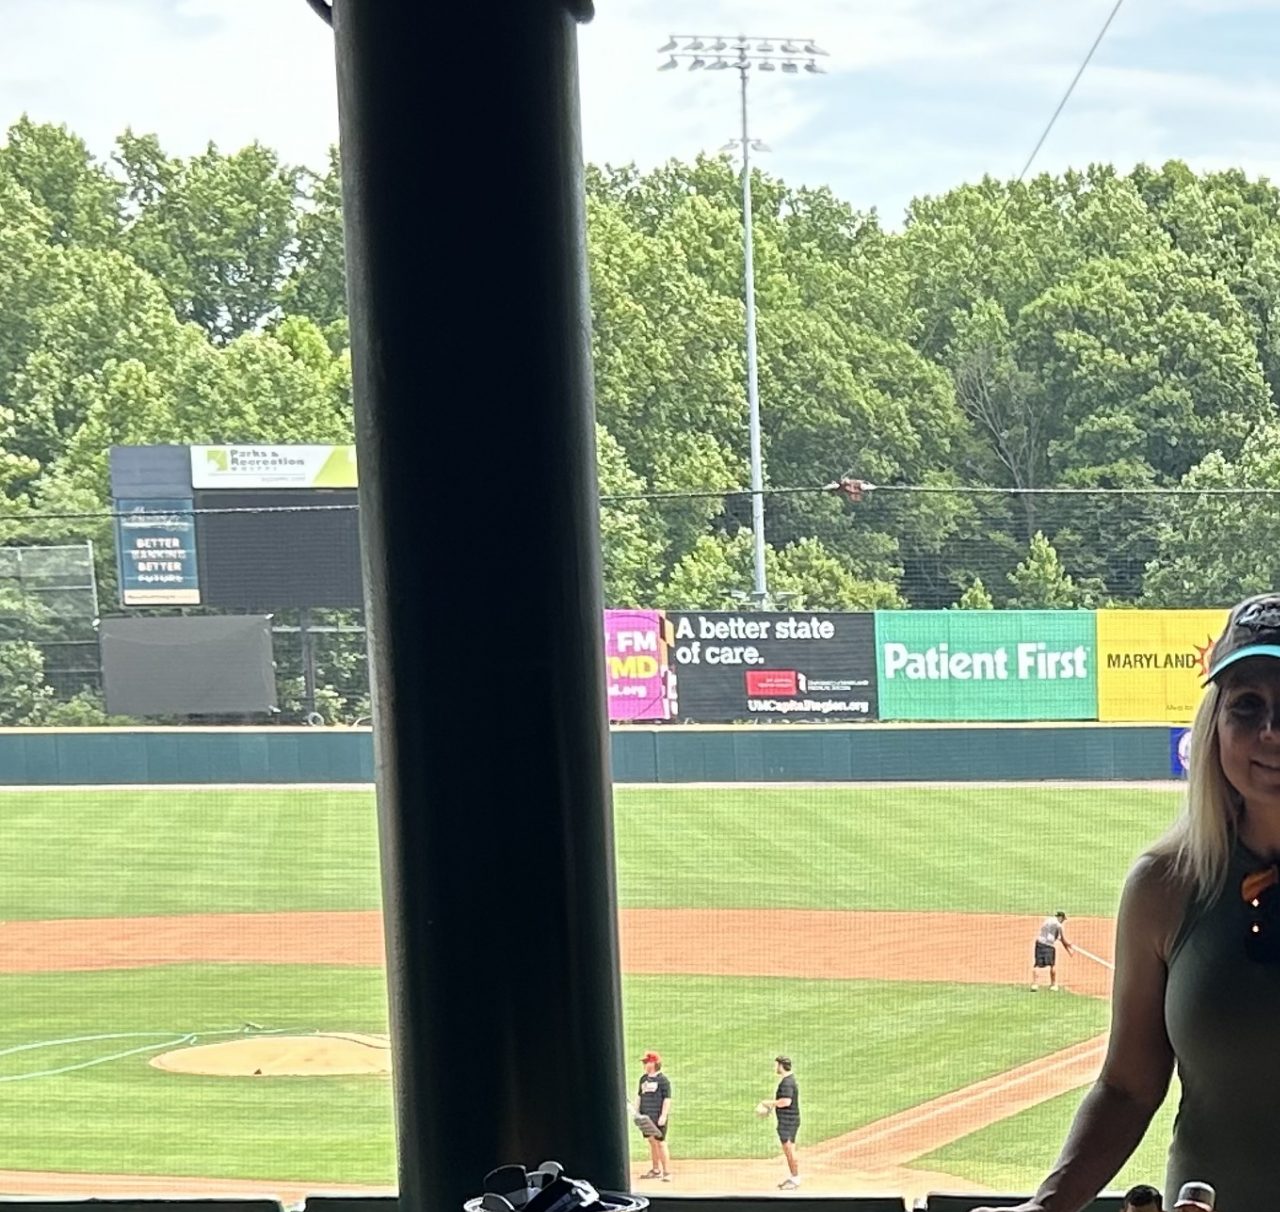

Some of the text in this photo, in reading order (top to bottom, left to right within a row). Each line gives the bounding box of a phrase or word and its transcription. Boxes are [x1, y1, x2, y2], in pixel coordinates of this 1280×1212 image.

[231, 457, 305, 466] Recreation
[136, 538, 180, 549] BETTER
[138, 561, 182, 572] BETTER
[675, 616, 835, 639] A better state
[617, 631, 658, 653] FM
[676, 641, 765, 664] of care.
[883, 641, 1088, 680] Patient First
[1107, 653, 1196, 670] MARYLAND
